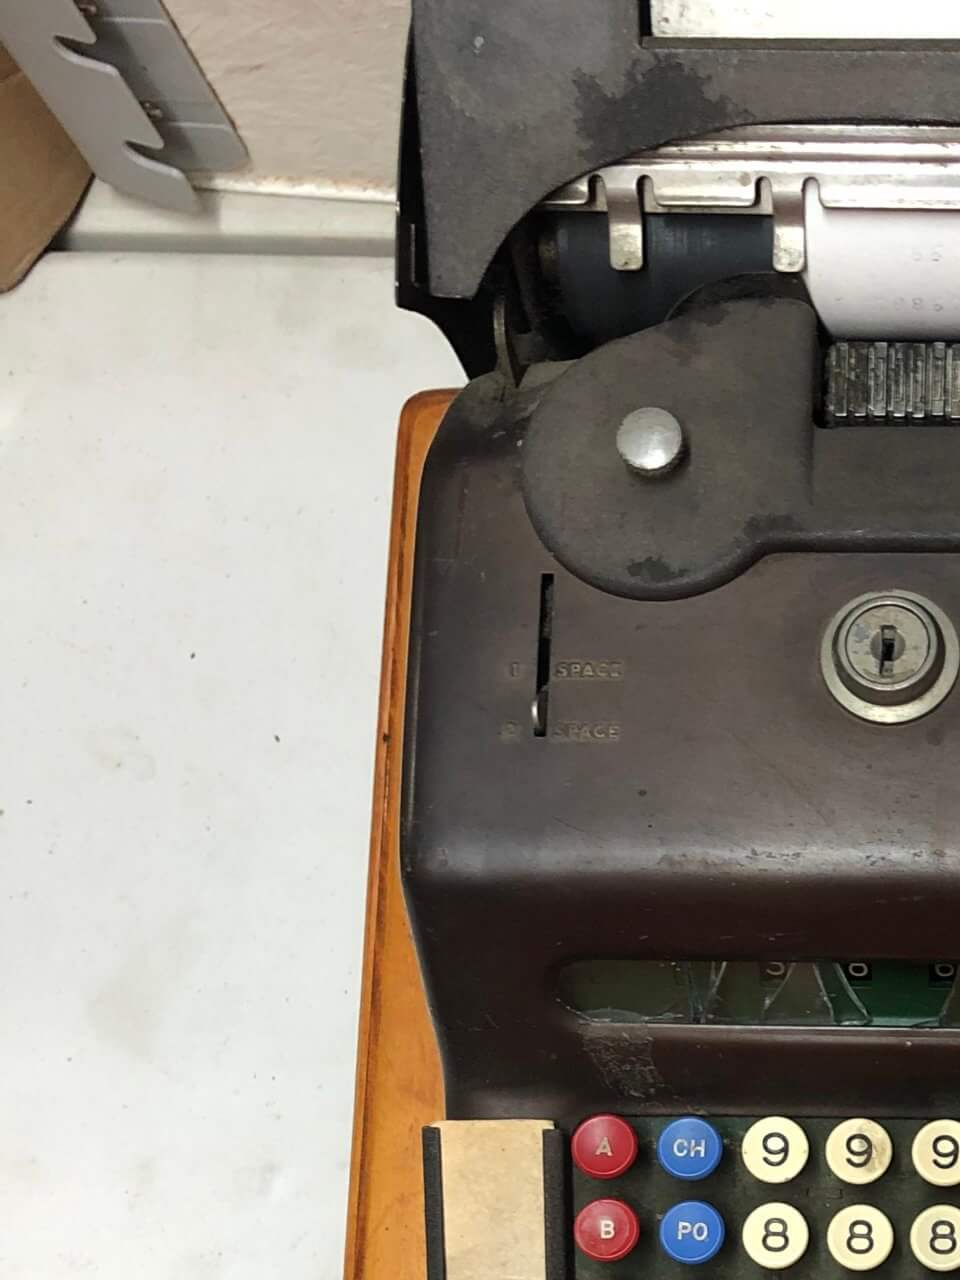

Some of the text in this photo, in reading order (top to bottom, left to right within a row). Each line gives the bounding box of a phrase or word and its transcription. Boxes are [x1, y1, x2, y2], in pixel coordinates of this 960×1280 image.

[595, 1137, 612, 1157] A
[673, 1139, 705, 1158] CH
[763, 1133, 789, 1166] 9
[846, 1134, 872, 1168] 9
[933, 1135, 959, 1169] 9
[600, 1220, 616, 1239] B
[677, 1222, 708, 1241] PO
[762, 1218, 788, 1252] 8
[847, 1220, 873, 1254] 8
[930, 1221, 956, 1254] 8
